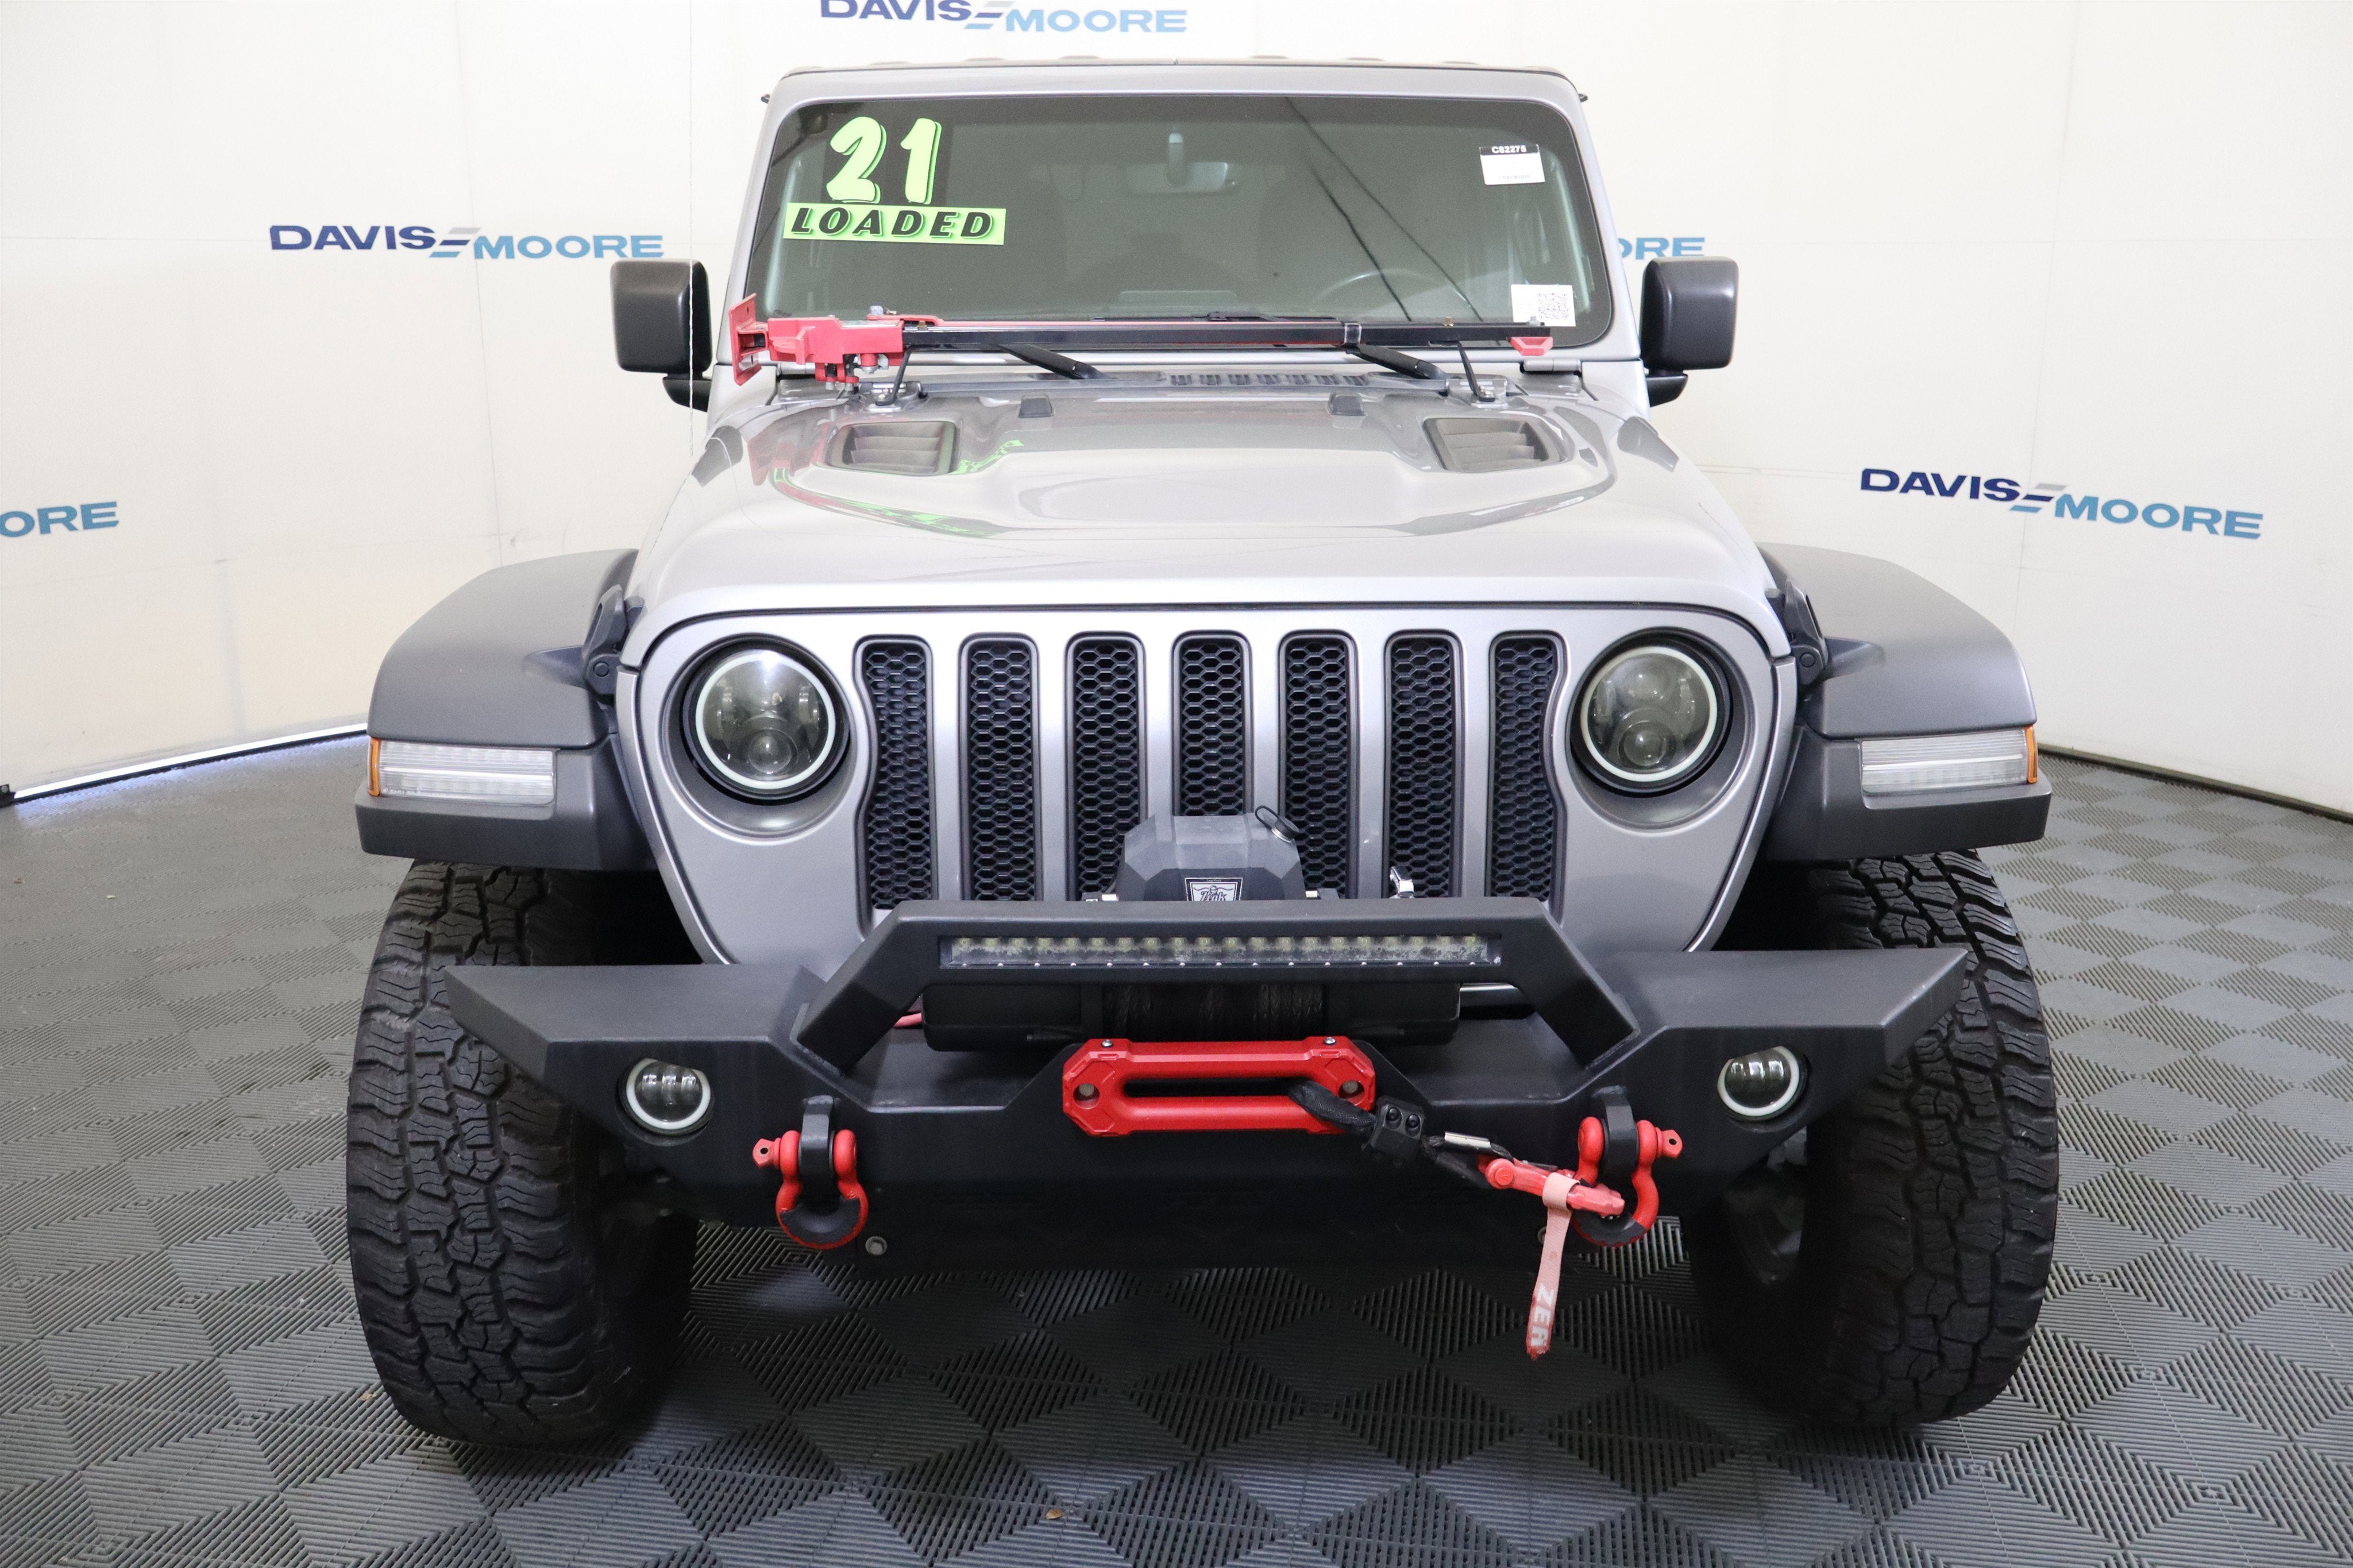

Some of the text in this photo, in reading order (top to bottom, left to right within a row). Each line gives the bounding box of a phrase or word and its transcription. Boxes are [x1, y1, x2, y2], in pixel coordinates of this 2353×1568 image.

[820, 0, 1187, 33] DAVIS MOORE
[826, 116, 942, 204] 21
[790, 207, 994, 239] LOADED
[269, 225, 664, 260] DAVIS MOORE
[1860, 468, 2264, 540] DAVIS MOORE
